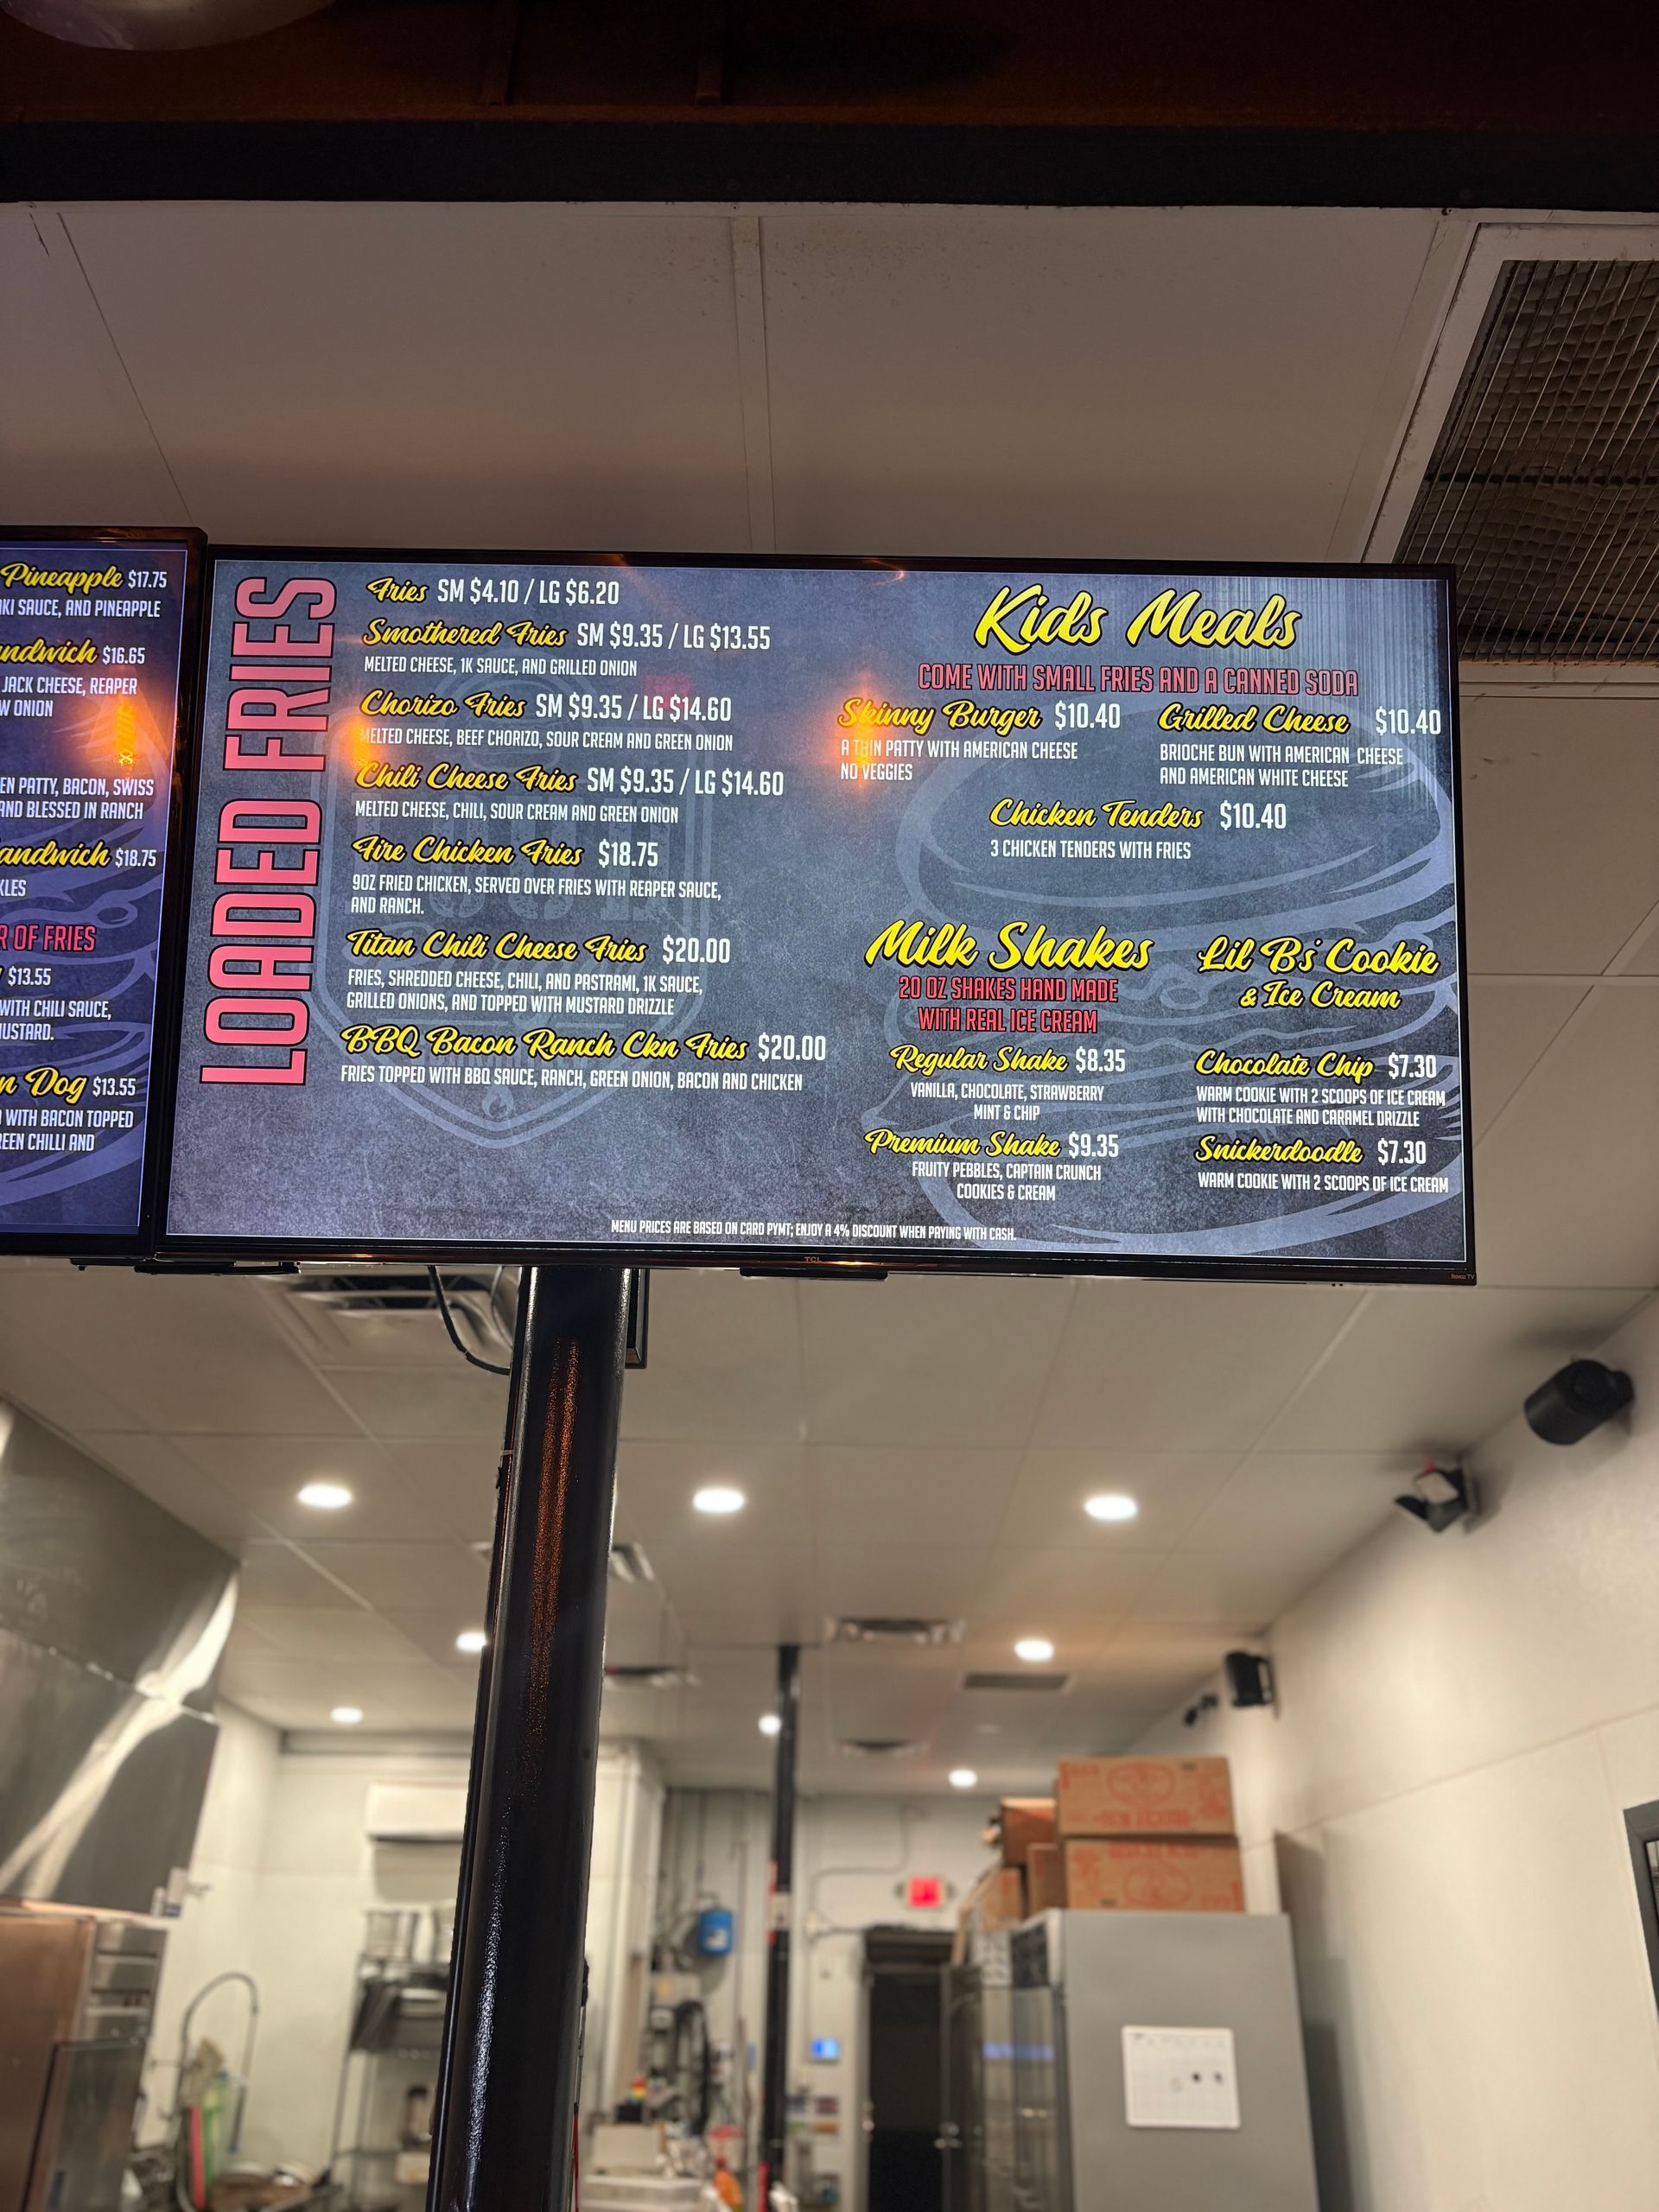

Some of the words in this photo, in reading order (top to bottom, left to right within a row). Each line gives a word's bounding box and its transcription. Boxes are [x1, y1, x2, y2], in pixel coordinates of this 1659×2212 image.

[1, 563, 124, 594] Pineapple
[128, 570, 168, 589] $17.75
[367, 576, 429, 602] Fries
[438, 579, 464, 602] SM
[470, 577, 518, 605] $4.10
[524, 579, 535, 605] /
[539, 581, 560, 604] LG
[566, 578, 620, 607] $6.20
[18, 600, 61, 618] SAUCE,
[65, 601, 91, 617] AND
[94, 601, 160, 618] PINEAPPLE
[975, 585, 1109, 655] Kids
[1126, 589, 1301, 648] Meals
[362, 619, 504, 645] Smothered
[506, 621, 568, 646] Fries
[576, 623, 604, 646] SM
[609, 621, 663, 649] $9.35
[668, 623, 679, 649] /
[684, 625, 704, 649] LG
[710, 623, 771, 651] $13.55
[102, 646, 145, 665] $16.65
[364, 656, 406, 672] MELTED
[410, 657, 456, 675] CHEESE,
[461, 658, 473, 673] 1K
[477, 658, 518, 677] SAUCE,
[522, 659, 546, 674] AND
[550, 659, 595, 676] GRILLED
[601, 660, 637, 677] ONION
[1, 677, 34, 693] JACK
[37, 677, 86, 696] CHEESE,
[90, 678, 137, 695] REAPER
[224, 576, 337, 772] FRIES
[918, 663, 972, 690] COME
[977, 664, 1027, 690] WITH
[1033, 664, 1096, 691] SMALL
[1101, 665, 1154, 692] FRIES
[1159, 667, 1198, 693] AND
[1205, 667, 1218, 694] A
[1224, 668, 1300, 695] CANNED
[1306, 670, 1358, 696] SODA
[360, 690, 458, 716] Chorizo
[465, 691, 526, 717] Fries
[536, 693, 562, 718] SM
[569, 692, 622, 721] $9.35
[627, 694, 639, 721] /
[643, 696, 664, 720] LG
[670, 694, 732, 722] $14.60
[838, 698, 935, 734] Skinny
[943, 700, 1042, 736] Burger
[1055, 700, 1121, 730] $10.40
[1159, 702, 1257, 732] Grilled
[1263, 704, 1351, 734] Cheese
[1376, 706, 1440, 735] $10.40
[356, 761, 423, 788] Chili
[426, 763, 510, 790] Cheese
[515, 766, 577, 791] Fries
[588, 767, 614, 792] SM
[620, 766, 674, 794] $9.35
[679, 768, 690, 795] /
[695, 770, 715, 794] LG
[721, 767, 784, 797] $14.60
[841, 763, 857, 779] NO
[862, 764, 912, 780] VEGGIES
[1160, 767, 1186, 785] AND
[1190, 768, 1255, 785] AMERICAN
[1259, 769, 1298, 786] WHITE
[1302, 770, 1348, 787] CHEESE
[19, 778, 58, 797] PATTY,
[63, 779, 110, 797] BACON,
[113, 779, 154, 796] SWISS
[0, 801, 22, 817] AND
[26, 802, 81, 819] BLESSED
[84, 803, 98, 819] IN
[101, 803, 143, 820] RANCH
[989, 798, 1096, 827] Chicken
[1102, 800, 1204, 829] Tenders
[1220, 800, 1286, 830] $10.40
[115, 849, 156, 868] $18.75
[353, 836, 406, 861] Fire
[412, 836, 516, 863] Chicken
[521, 839, 583, 865] Fries
[598, 839, 658, 868] $18.75
[990, 840, 998, 856] 3
[1003, 840, 1056, 858] CHICKEN
[1060, 842, 1115, 858] TENDERS
[1119, 842, 1152, 859] WITH
[1156, 842, 1191, 860] FRIES
[13, 925, 40, 950] OF
[43, 925, 95, 951] FRIES
[200, 799, 321, 1085] LOADED
[347, 929, 416, 957] Titan
[423, 931, 489, 958] Chili
[494, 931, 578, 961] Cheese
[584, 934, 649, 963] Fries
[663, 934, 730, 965] $20.00
[865, 920, 978, 969] Milk
[989, 921, 1154, 970] Shakes
[1198, 936, 1255, 972] Lil
[1325, 938, 1440, 974] Cookie
[899, 976, 920, 999] 20
[926, 977, 946, 999] OZ
[951, 978, 1014, 1001] SHAKES
[1020, 979, 1065, 1001] HAND
[1072, 980, 1118, 1002] MADE
[1240, 987, 1256, 1007] &
[1263, 981, 1303, 1007] Ice
[1311, 981, 1401, 1008] Cream
[0, 1000, 30, 1017] WITH
[34, 1001, 65, 1018] CHILI
[68, 1001, 111, 1020] SAUCE,
[918, 1007, 960, 1031] WITH
[966, 1008, 1005, 1032] REAL
[1010, 1009, 1036, 1032] ICE
[1040, 1010, 1097, 1033] CREAM
[340, 1025, 421, 1057] BBQ
[427, 1026, 517, 1056] Bacon
[523, 1027, 616, 1061] Ranch
[622, 1030, 680, 1059] Ckn
[685, 1033, 750, 1060] Fries
[759, 1032, 826, 1062] $20.00
[890, 1045, 988, 1076] Regular
[994, 1046, 1068, 1072] Shake
[1076, 1048, 1125, 1073] $8.35
[1195, 1050, 1310, 1077] Chocolate
[1315, 1052, 1374, 1084] Chip
[1388, 1052, 1437, 1079] $7.30
[25, 1067, 87, 1103] Dog
[92, 1077, 137, 1096] $13.55
[864, 1128, 980, 1155] Premium
[985, 1131, 1060, 1157] Shake
[1069, 1132, 1118, 1158] $9.35
[1195, 1136, 1363, 1163] Snickerdoodle
[1377, 1138, 1426, 1166] $7.30
[612, 1219, 637, 1233] MENU
[639, 1220, 671, 1234] PRICES
[674, 1221, 691, 1234] ARE
[694, 1222, 721, 1235] BASED
[725, 1222, 738, 1235] ON
[741, 1223, 765, 1236] CARD
[767, 1223, 794, 1238] PYMT;
[796, 1224, 823, 1237] ENJOY
[825, 1224, 832, 1236] A
[834, 1224, 850, 1237] 4%
[853, 1224, 898, 1238] DISCOUNT
[899, 1225, 925, 1238] WHEN
[929, 1225, 961, 1239] PAYING
[963, 1226, 987, 1240] WITH
[989, 1227, 1017, 1241] CASH.
